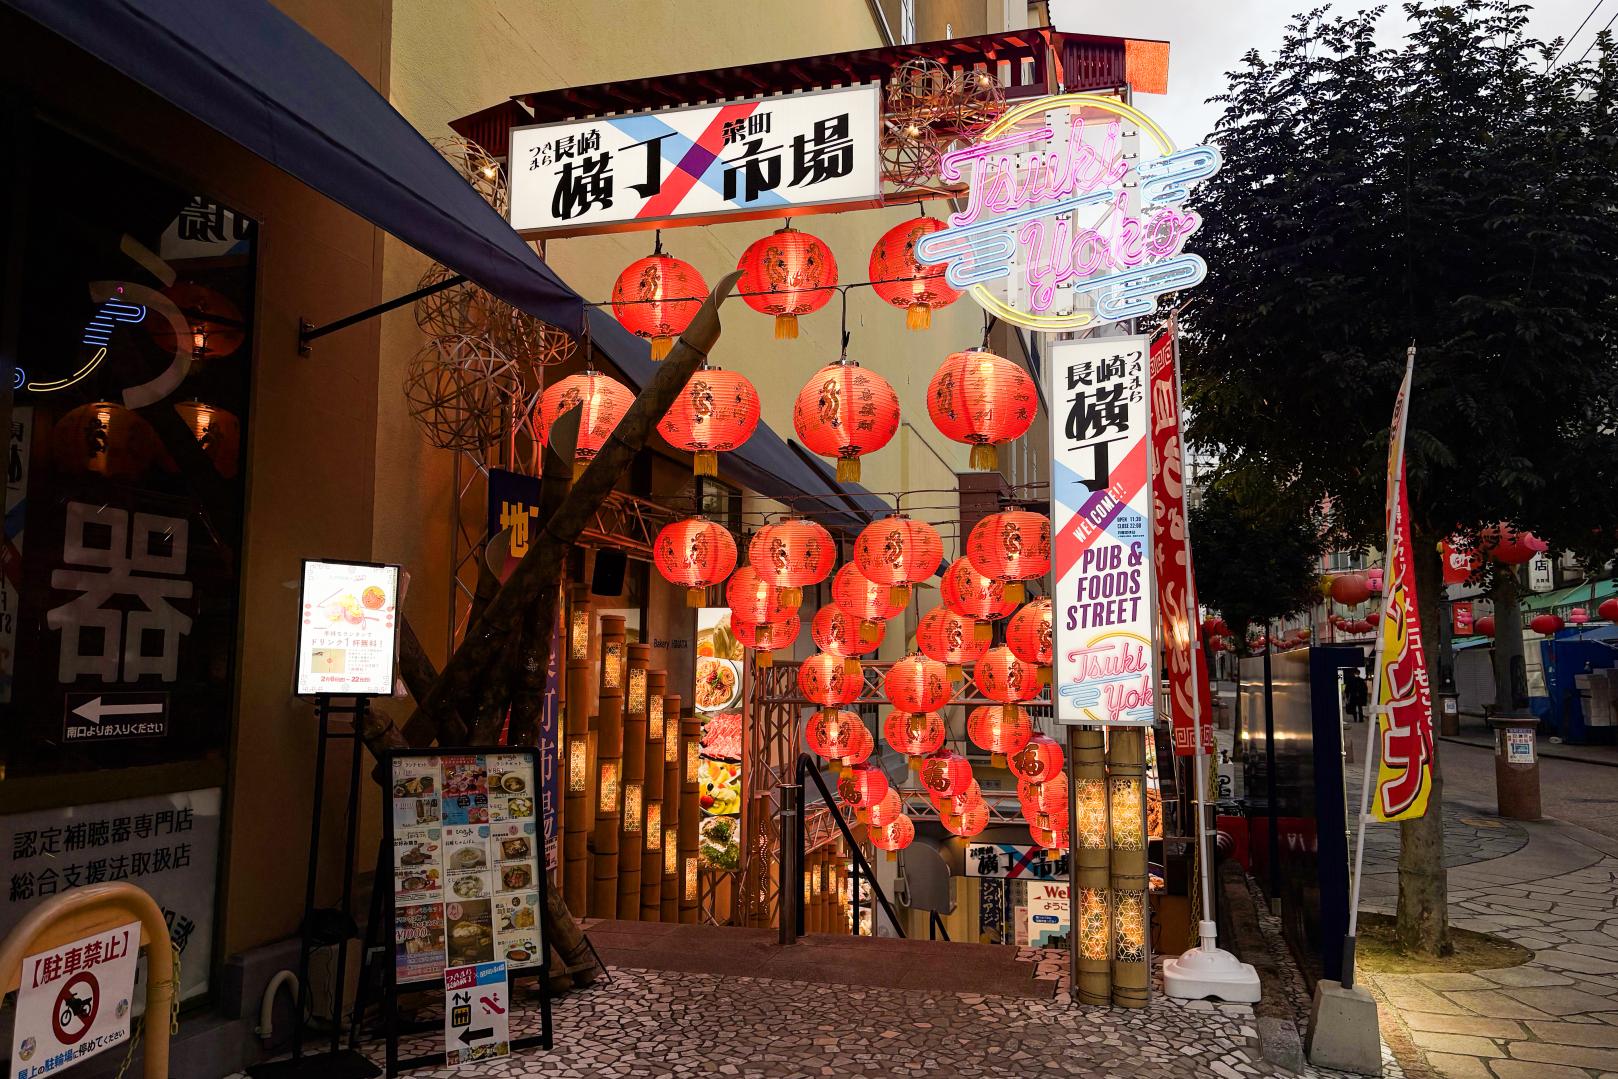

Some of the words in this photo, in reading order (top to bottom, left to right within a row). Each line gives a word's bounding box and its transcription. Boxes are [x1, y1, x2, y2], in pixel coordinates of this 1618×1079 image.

[553, 128, 601, 162] 長崎
[721, 111, 773, 146] 築町
[551, 131, 678, 221] 横丁
[721, 112, 854, 202] 市場
[941, 118, 1129, 226] Tsuki
[1020, 191, 1196, 311] Yoko
[1065, 355, 1126, 390] 長崎
[1065, 383, 1129, 492] 横丁
[1072, 482, 1127, 543] WELCOME!!
[1082, 545, 1121, 574] PUB
[1128, 541, 1142, 566] &
[1077, 569, 1141, 602] FOODS
[1067, 597, 1142, 631] STREET
[1068, 643, 1147, 683] Tsuki
[67, 722, 163, 738] 南口よりお入りください
[13, 808, 194, 860] 認定補聴器専門店
[9, 843, 191, 902] 総合支援法取扱店
[1044, 902, 1068, 911] ようこ
[32, 931, 129, 988] 【駐車禁止】
